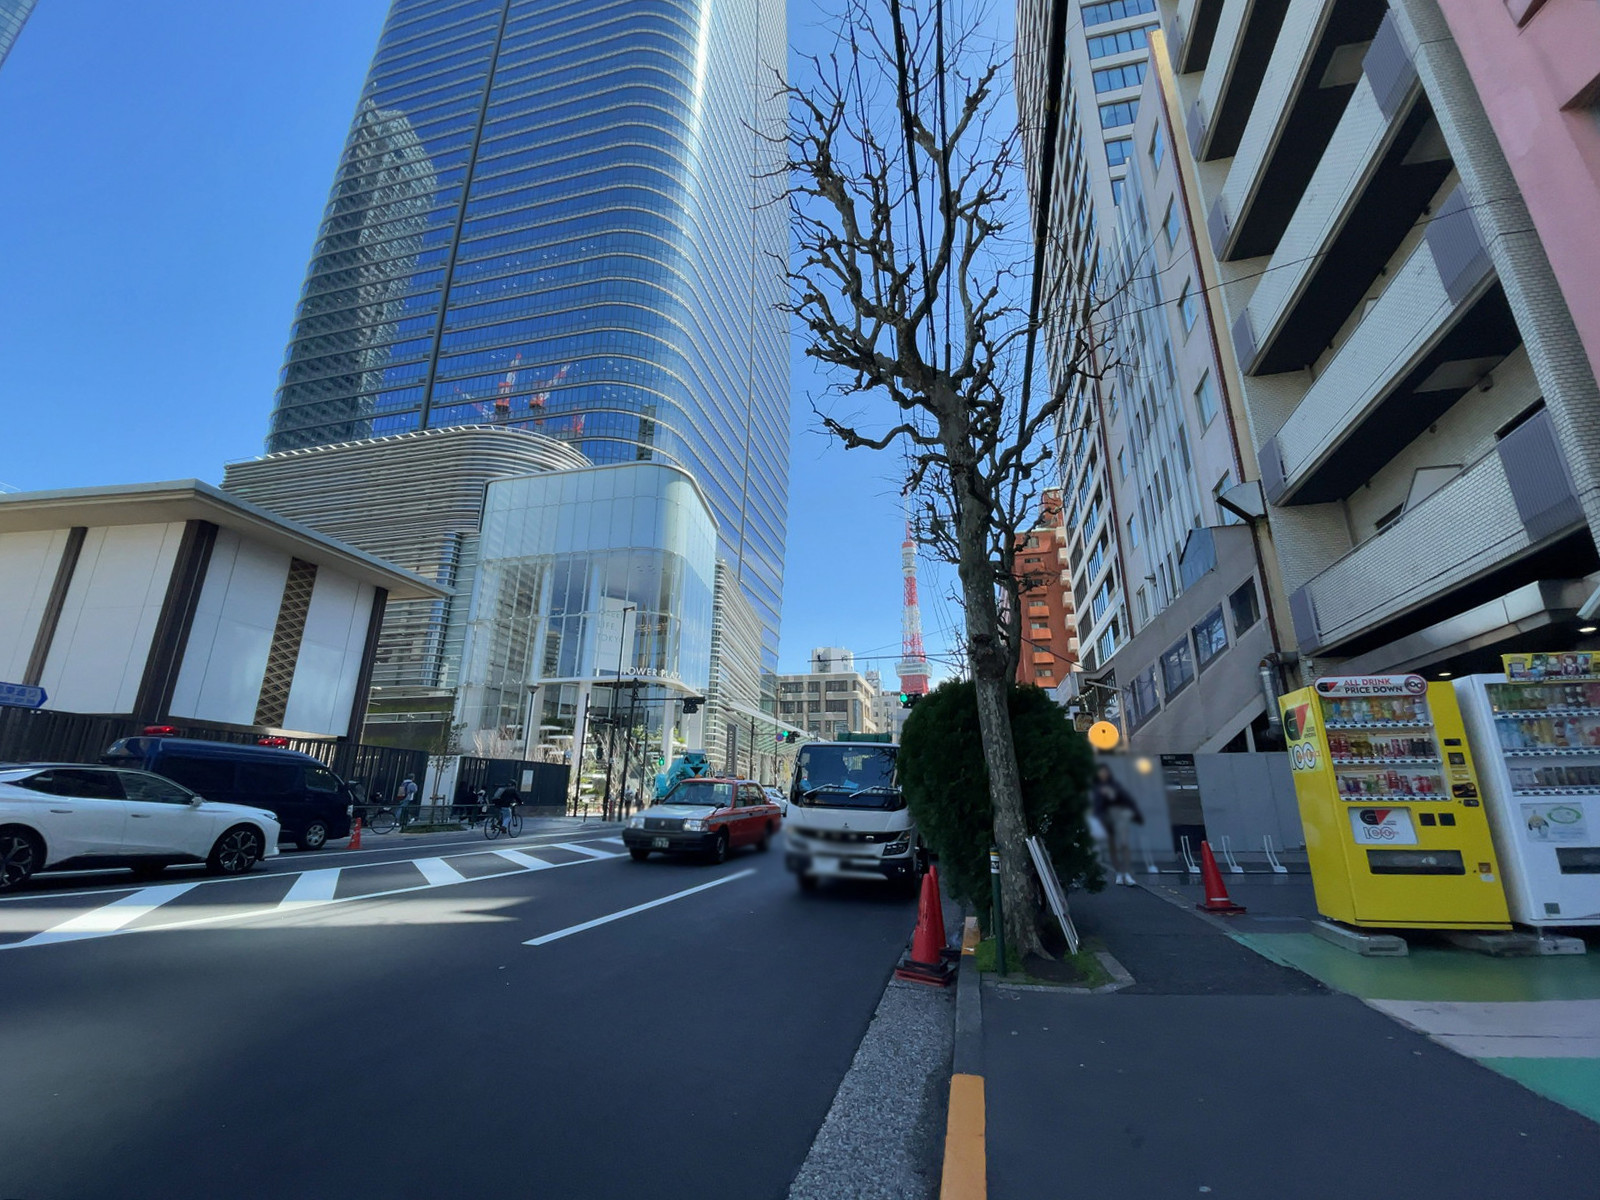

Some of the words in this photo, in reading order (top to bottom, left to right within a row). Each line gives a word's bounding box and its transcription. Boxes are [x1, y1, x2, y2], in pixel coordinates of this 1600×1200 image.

[1361, 678, 1392, 686] DRINK
[1344, 685, 1371, 694] PRICE
[1288, 741, 1316, 770] 100
[1363, 826, 1395, 840] 100
